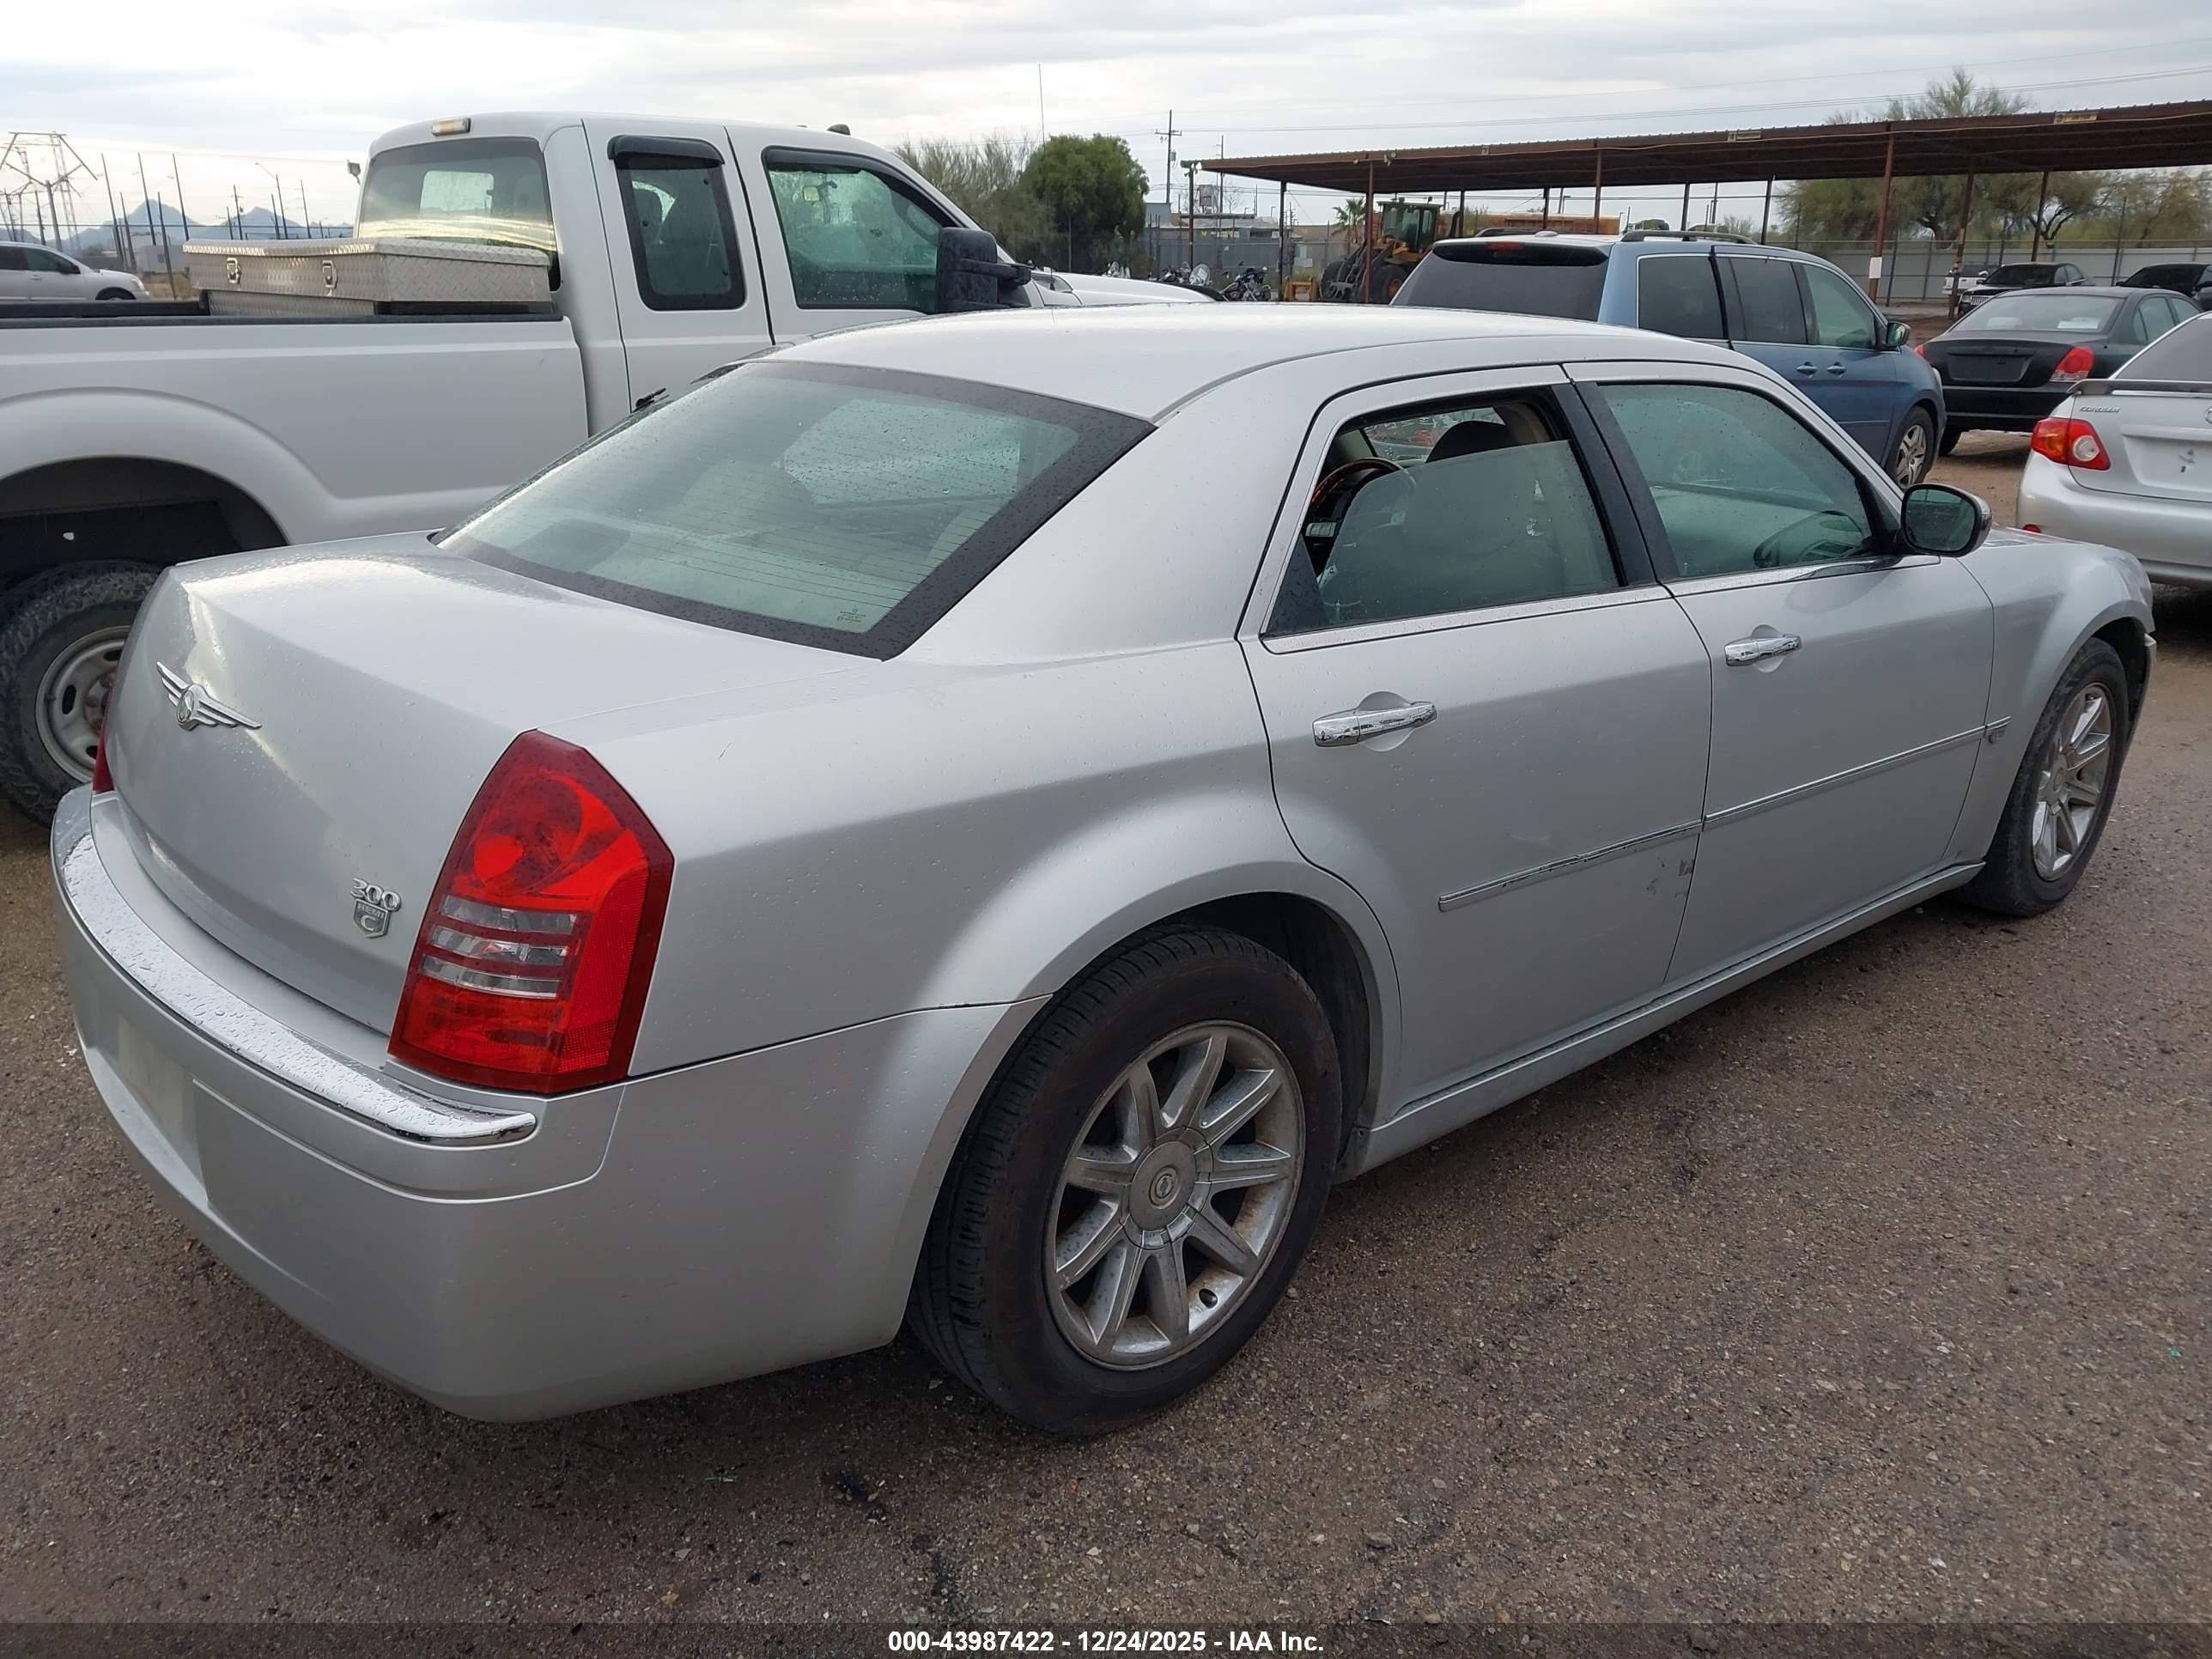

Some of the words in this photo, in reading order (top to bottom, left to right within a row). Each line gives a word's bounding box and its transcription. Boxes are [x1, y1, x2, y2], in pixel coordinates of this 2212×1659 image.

[349, 877, 401, 912] 300
[356, 902, 386, 920] HEMI
[361, 915, 377, 932] C
